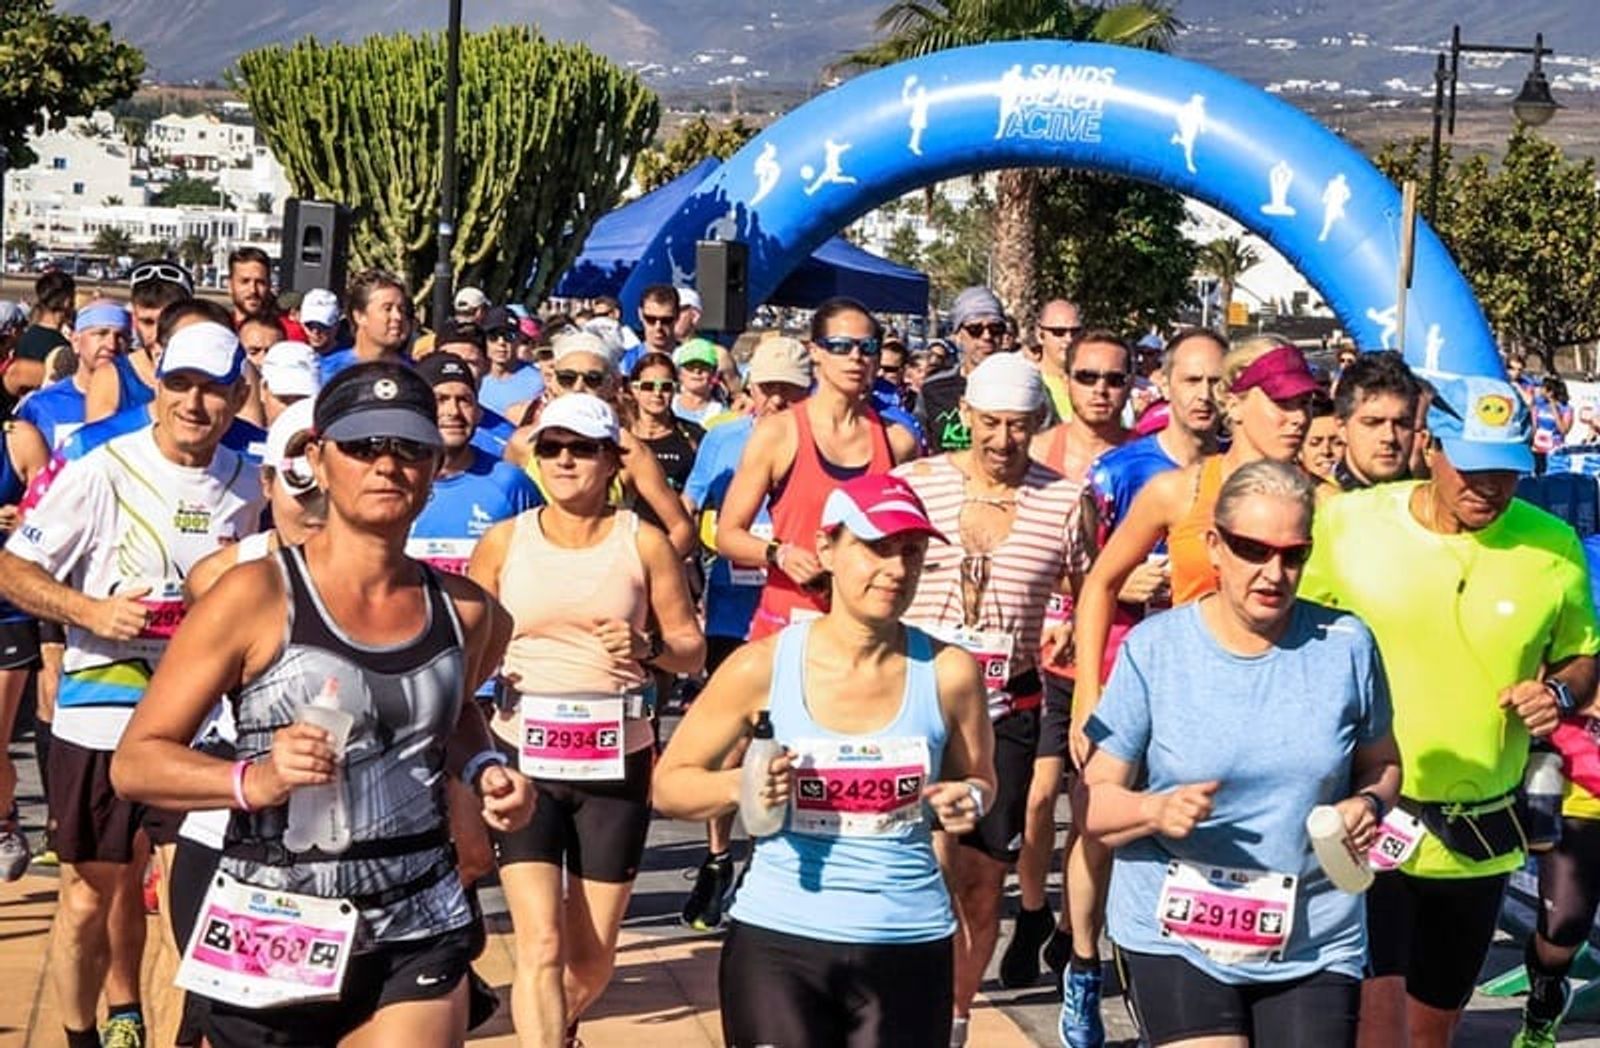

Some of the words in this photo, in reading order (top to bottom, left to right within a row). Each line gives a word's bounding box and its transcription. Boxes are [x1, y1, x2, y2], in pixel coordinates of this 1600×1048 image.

[1031, 64, 1117, 88] SANDS
[1016, 86, 1105, 110] BEACH
[1006, 108, 1103, 143] ACTIVE
[547, 730, 597, 749] 2934
[828, 779, 895, 800] 2429
[1194, 902, 1257, 931] 2919
